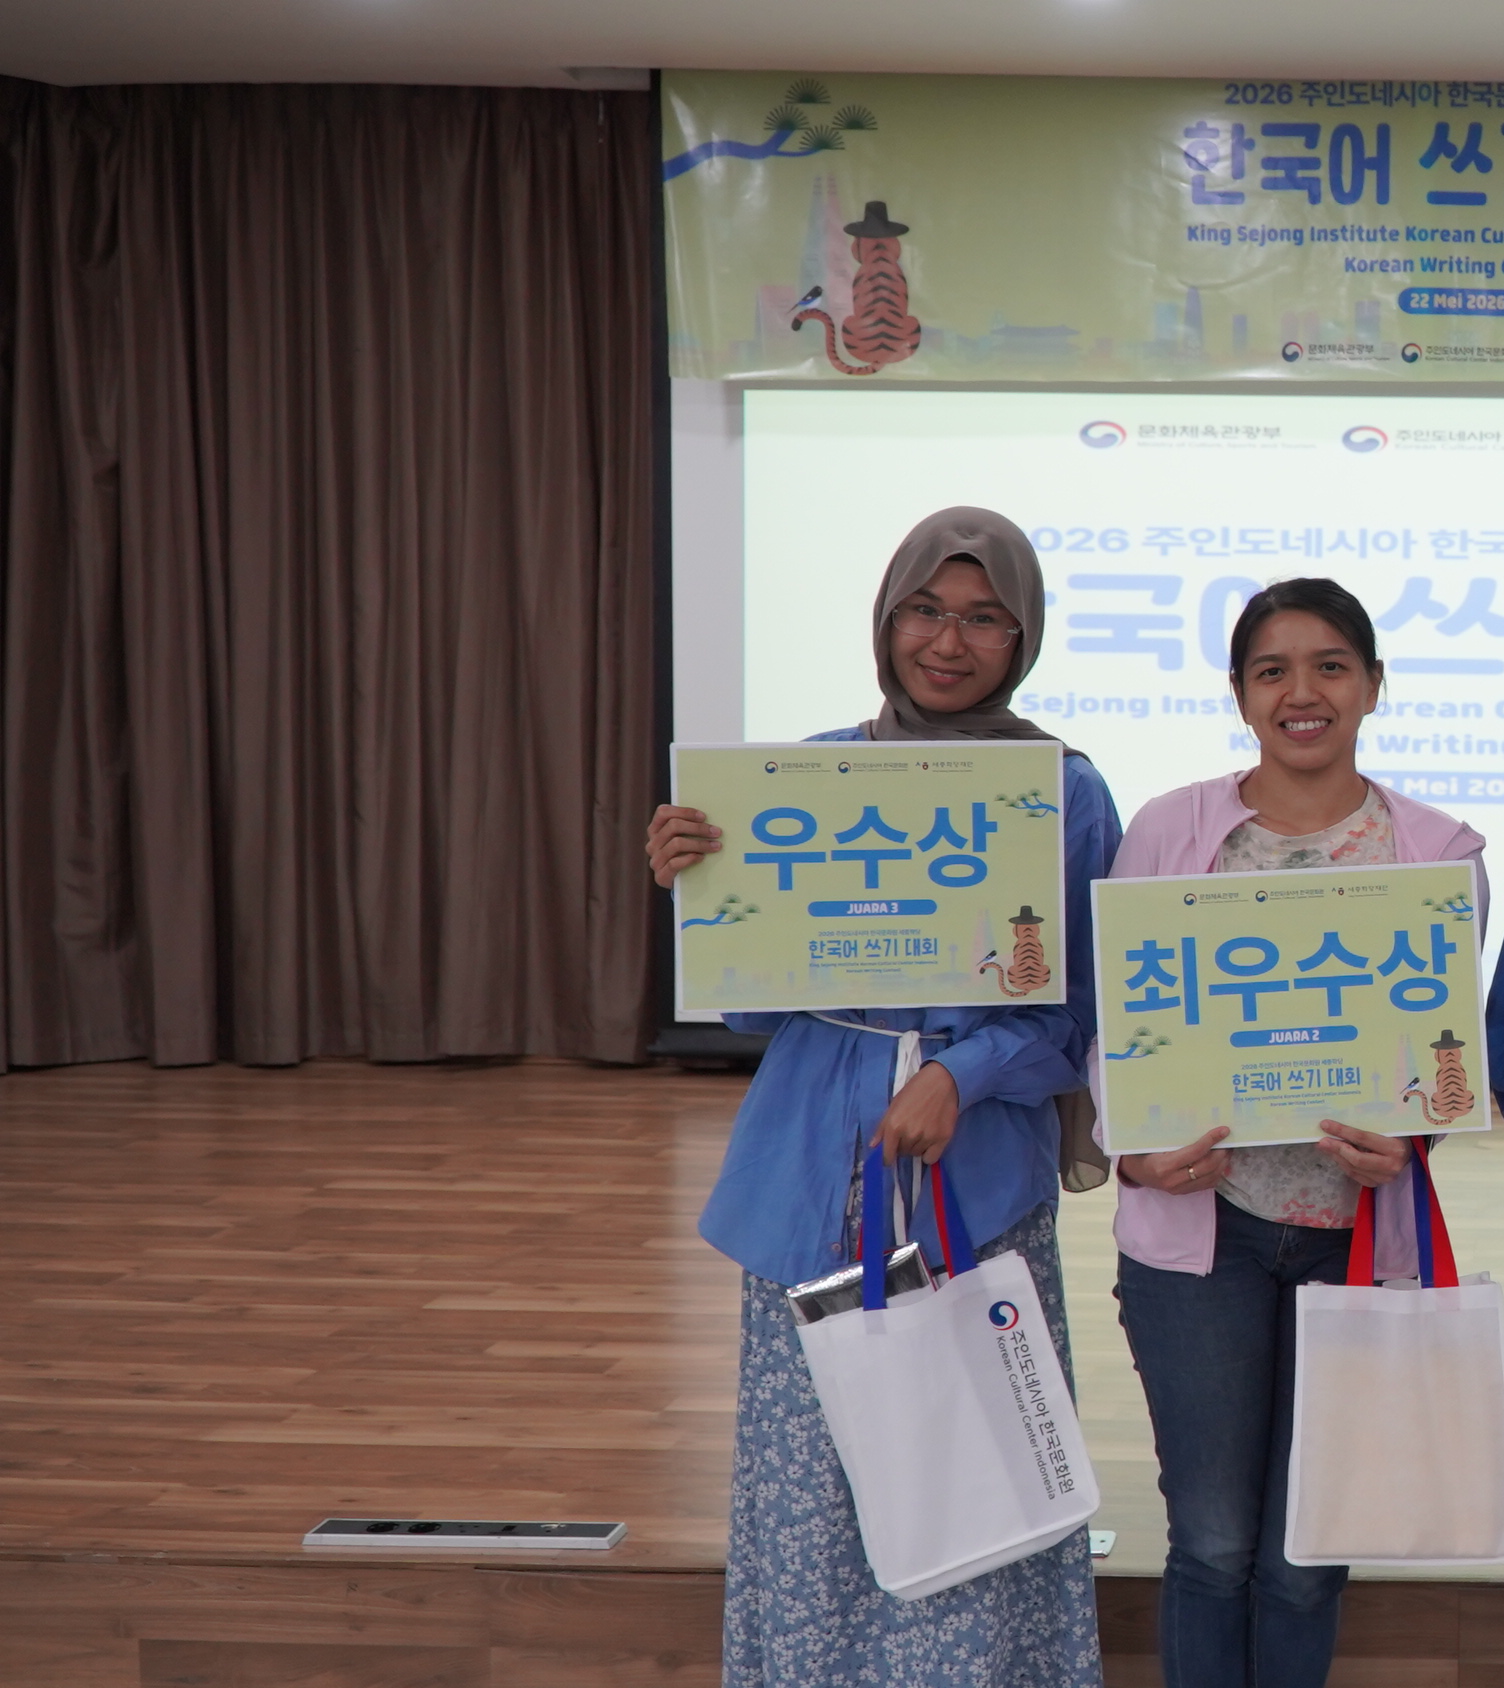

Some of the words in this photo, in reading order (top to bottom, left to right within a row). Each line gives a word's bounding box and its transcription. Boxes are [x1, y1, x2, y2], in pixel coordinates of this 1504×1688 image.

[1225, 83, 1293, 105] 2026
[1300, 81, 1442, 107] 주인도네시아
[1183, 120, 1390, 205] 한국어
[1187, 225, 1231, 246] King
[1237, 225, 1304, 246] Sejong
[1310, 225, 1399, 242] Institute
[1405, 226, 1475, 243] Korean
[1344, 257, 1414, 273] Korean
[1420, 256, 1495, 278] Writing
[1410, 293, 1429, 308] 22
[1433, 293, 1461, 309] Mei
[1137, 424, 1282, 440] 문화체육관광부
[1396, 428, 1501, 442] 주인도네시아
[1028, 527, 1129, 552] 026
[1142, 526, 1417, 560] 주인도네시아
[1020, 692, 1150, 719] Sejong
[1375, 700, 1483, 719] orean
[1404, 777, 1458, 795] Mei
[744, 802, 998, 891] 우수상
[847, 902, 888, 914] JUARA
[891, 903, 898, 913] 3
[808, 940, 858, 959] 한국어
[864, 938, 898, 957] 쓰기
[905, 938, 938, 956] 대회
[1124, 923, 1457, 1025] 최우수상
[1269, 1030, 1309, 1043] JUARA
[1312, 1030, 1320, 1041] 2
[1232, 1071, 1282, 1093] 한국어
[1287, 1068, 1321, 1089] 쓰기
[1327, 1067, 1361, 1087] 대회
[996, 1335, 1013, 1371] Korean
[1009, 1373, 1028, 1413] Cultural
[1022, 1415, 1039, 1448] Center
[1034, 1450, 1056, 1500] Indonesia
[1010, 1330, 1050, 1417] 주인도네시아
[1038, 1420, 1075, 1494] 한국문화원
